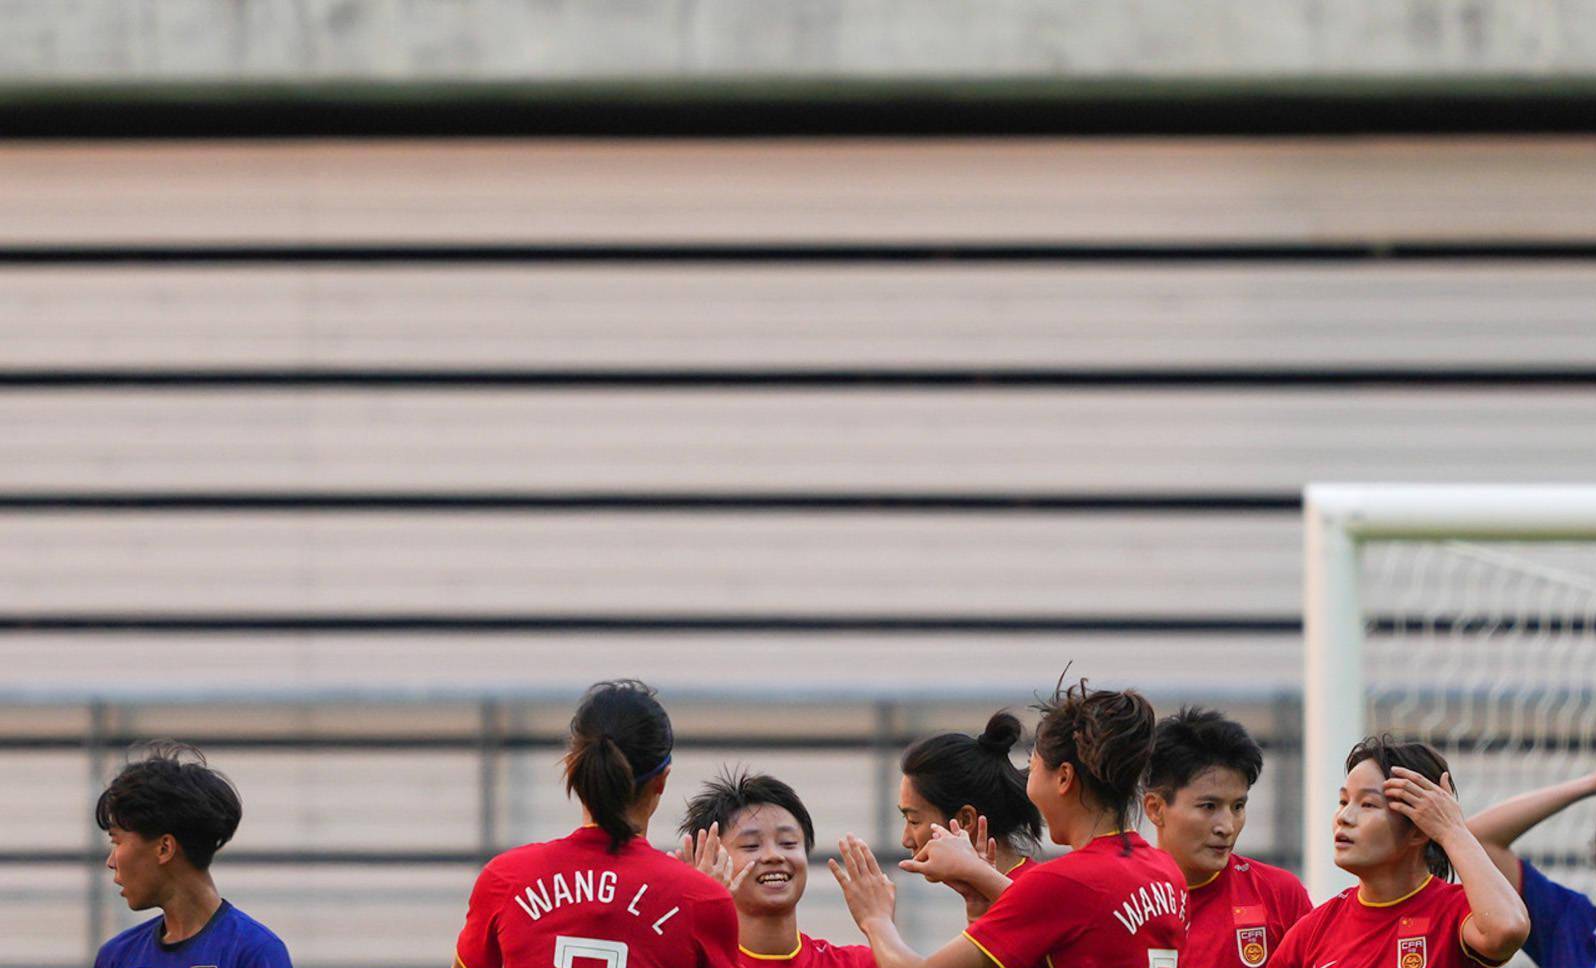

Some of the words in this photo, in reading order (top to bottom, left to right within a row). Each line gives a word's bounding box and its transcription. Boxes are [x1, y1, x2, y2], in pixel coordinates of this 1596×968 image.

[514, 869, 618, 921] WANG
[627, 883, 648, 916] L
[652, 906, 679, 935] L
[1113, 882, 1176, 935] WANG
